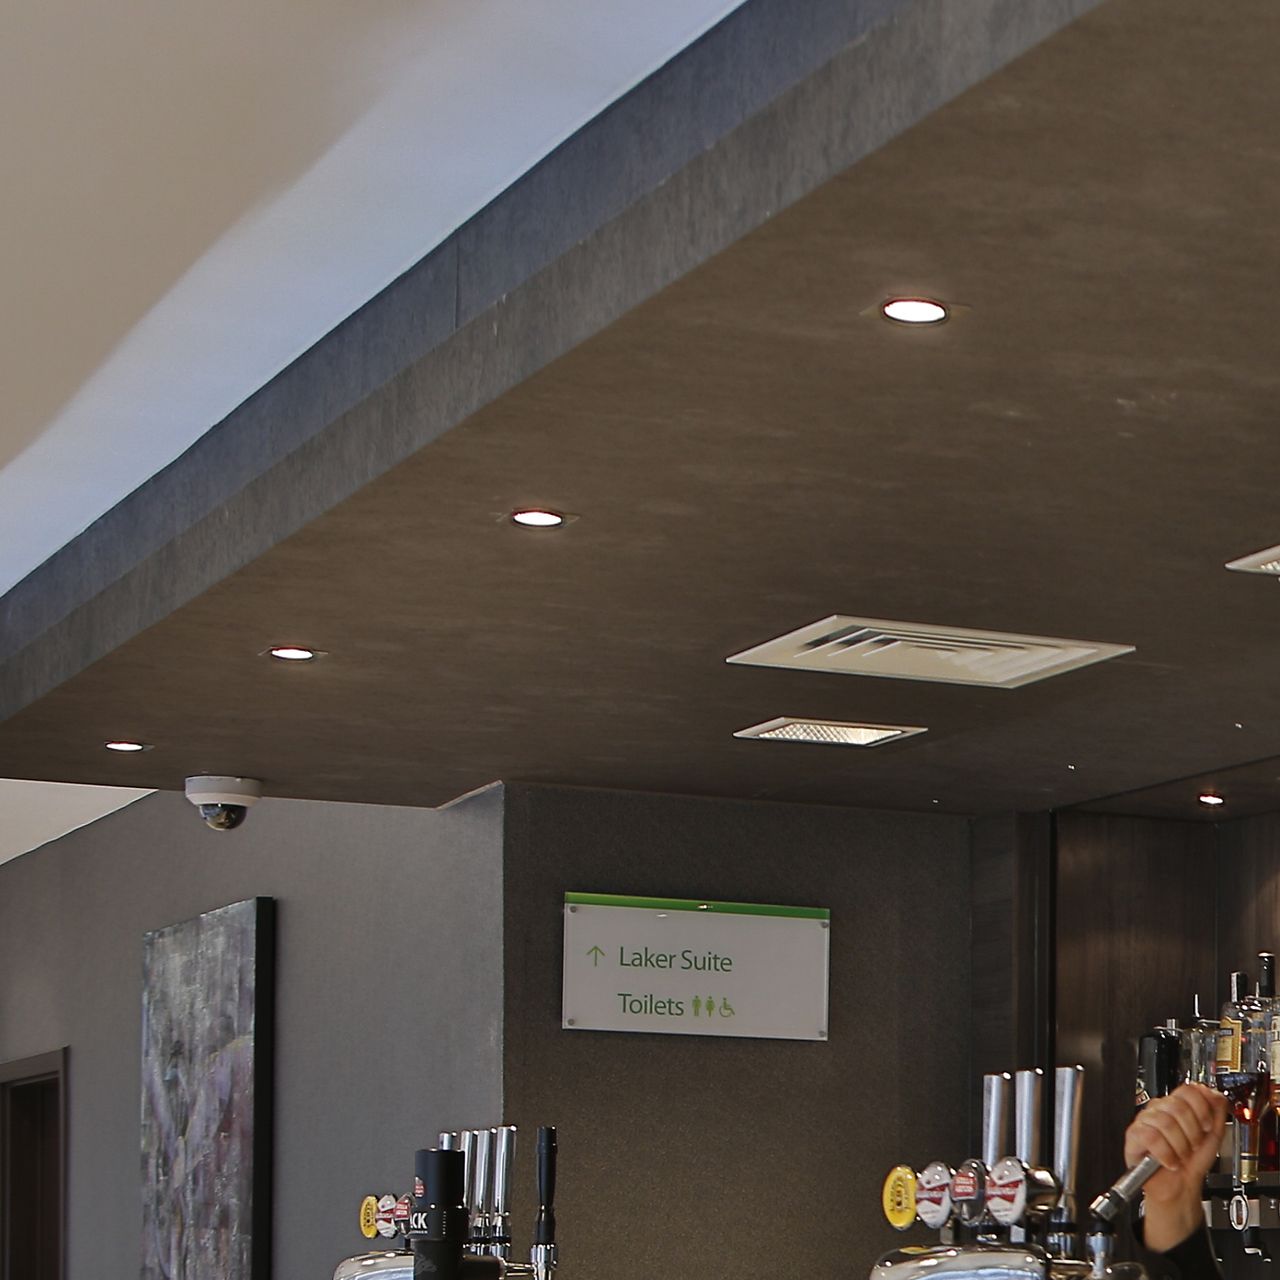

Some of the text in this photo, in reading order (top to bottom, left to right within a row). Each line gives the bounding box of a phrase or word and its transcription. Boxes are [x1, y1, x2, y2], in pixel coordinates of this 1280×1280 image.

[620, 946, 733, 972] Laker Suite
[617, 993, 685, 1016] Toilets
